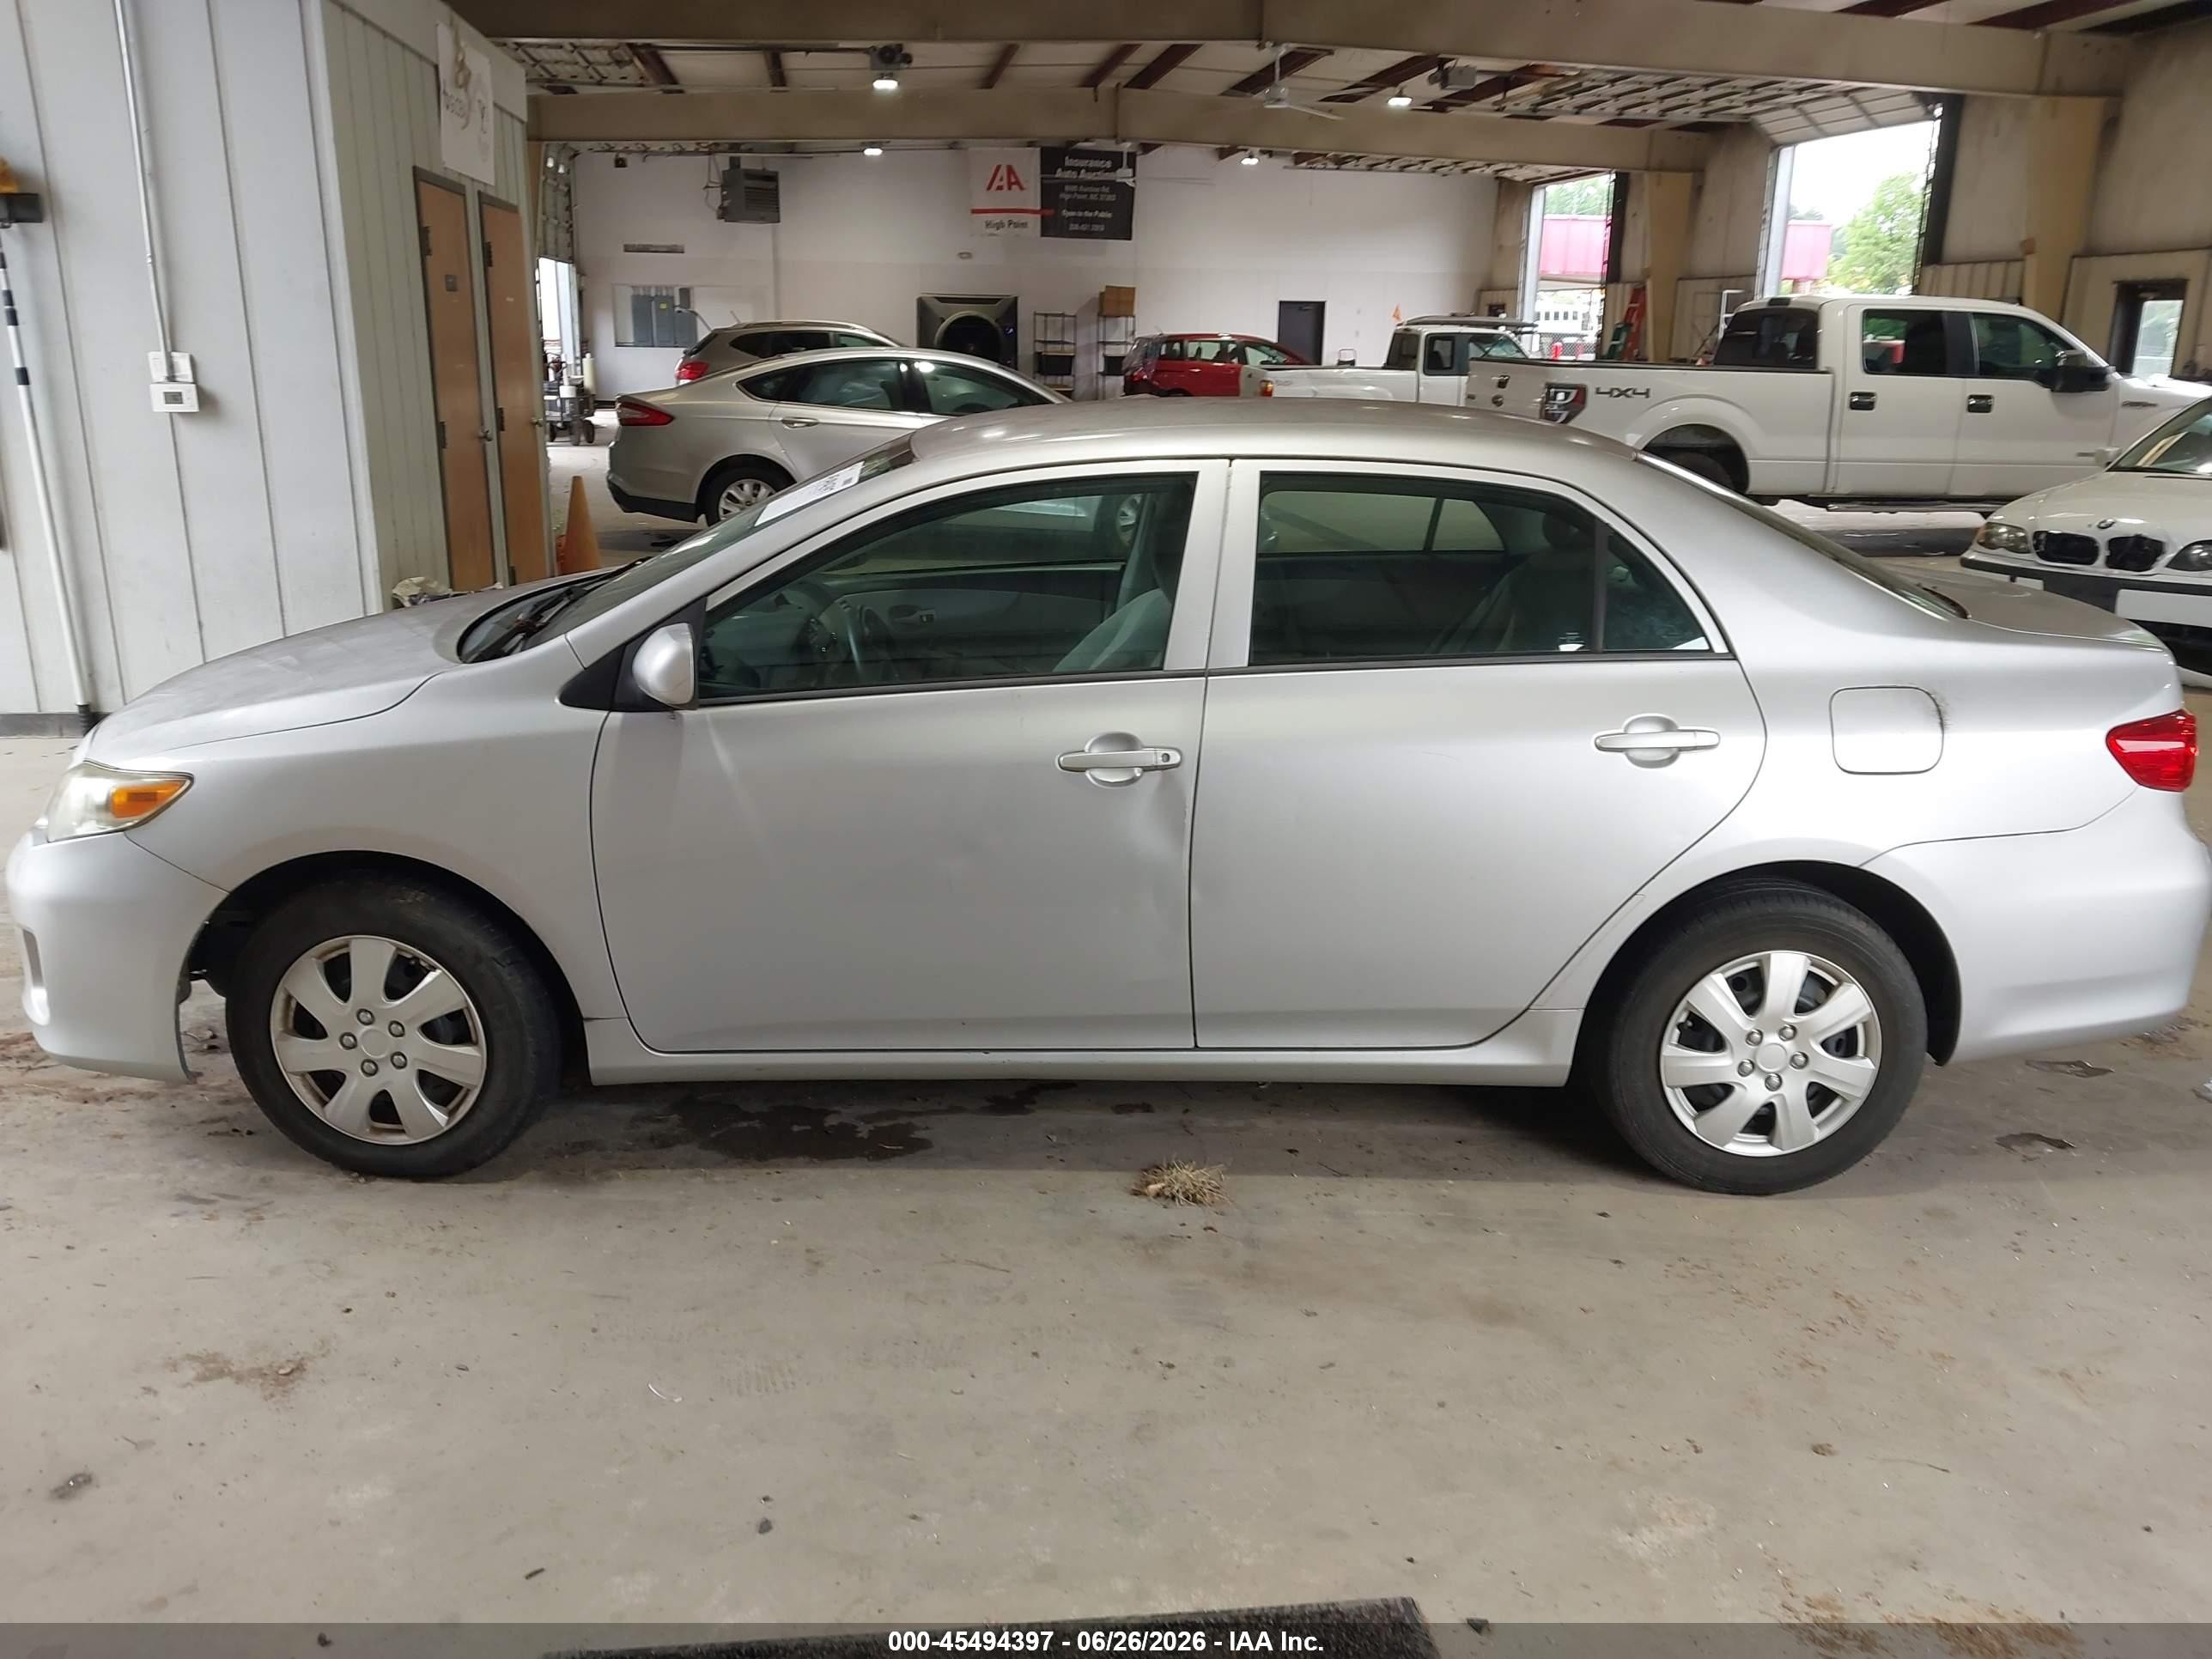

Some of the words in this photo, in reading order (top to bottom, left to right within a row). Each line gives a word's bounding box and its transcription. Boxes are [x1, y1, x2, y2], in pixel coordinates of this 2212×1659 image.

[1064, 155, 1112, 168] Insurance
[1054, 167, 1077, 179] Auto
[1078, 168, 1116, 180] Auction
[984, 219, 1006, 231] High
[1006, 219, 1028, 228] Point
